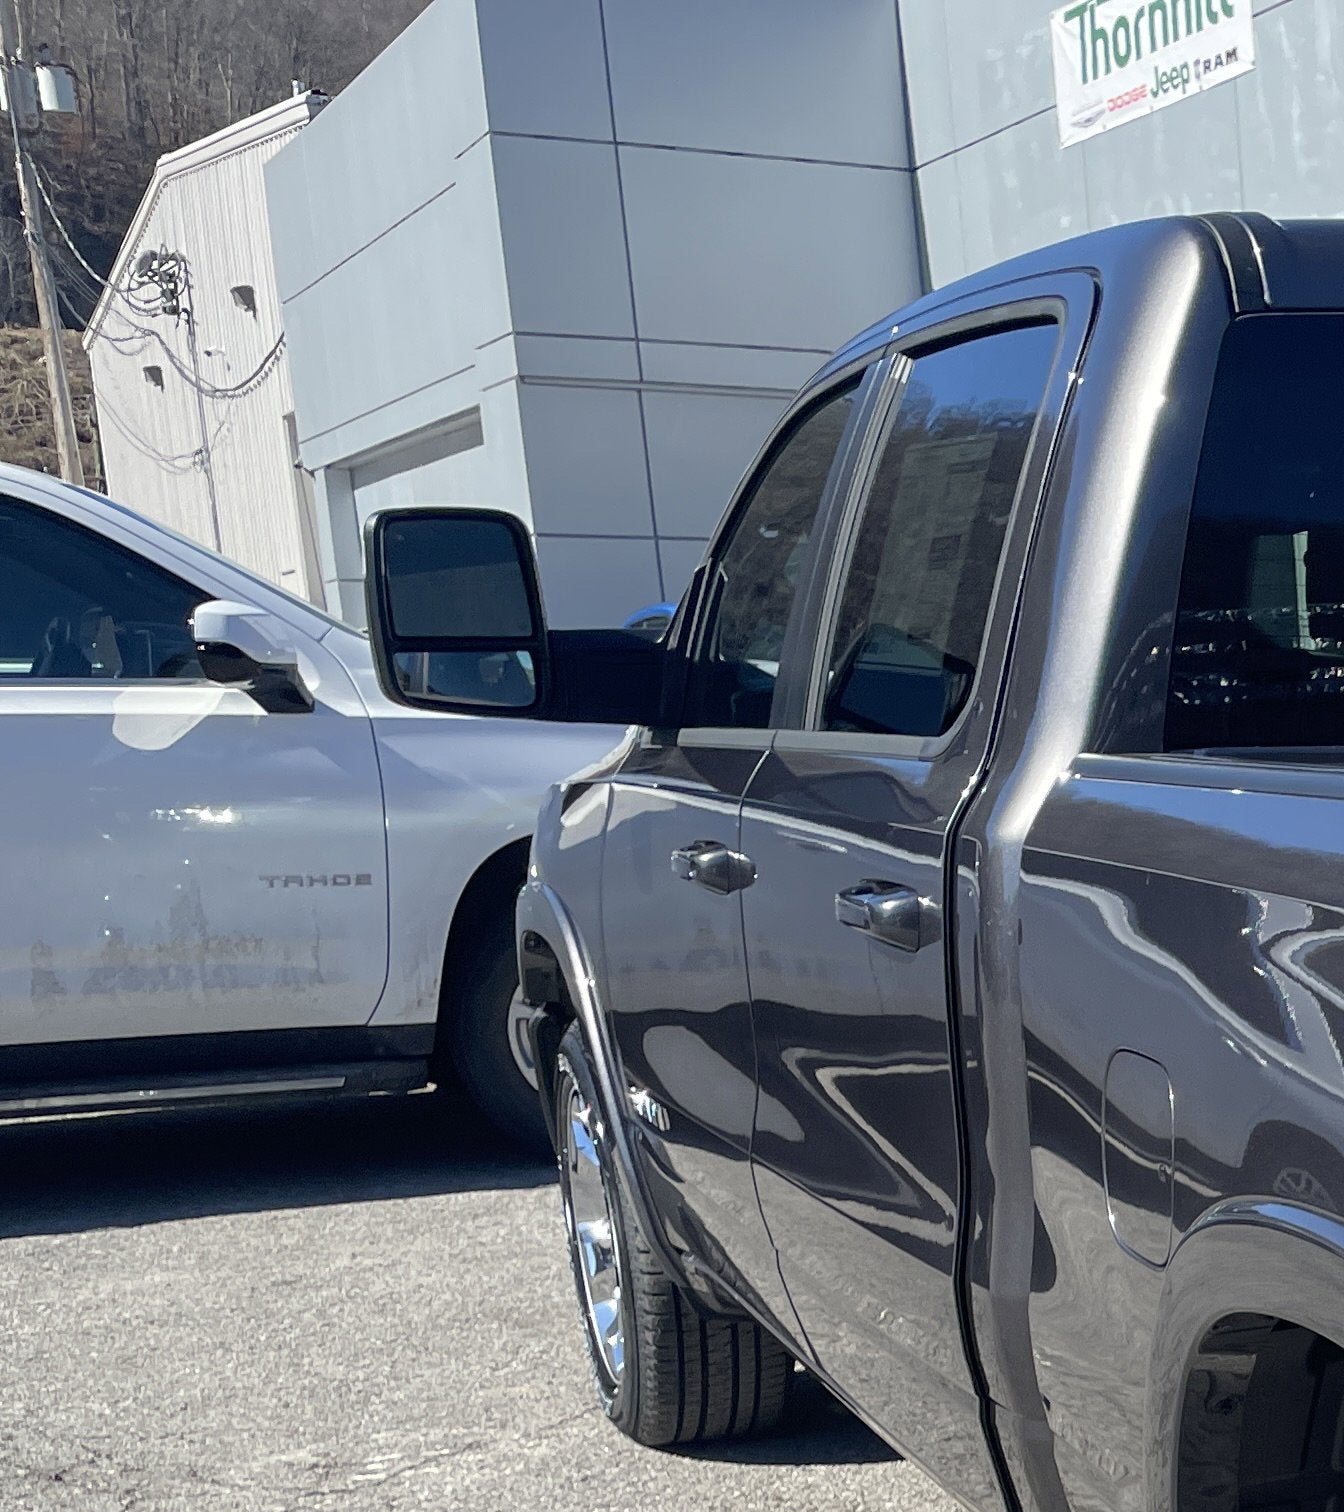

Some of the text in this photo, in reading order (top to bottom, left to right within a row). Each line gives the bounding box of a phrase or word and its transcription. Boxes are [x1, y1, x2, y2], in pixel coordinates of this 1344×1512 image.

[1107, 84, 1148, 112] DODGE
[1150, 62, 1191, 98] Jeep
[1203, 47, 1238, 74] RAM
[258, 873, 373, 889] TAHOE
